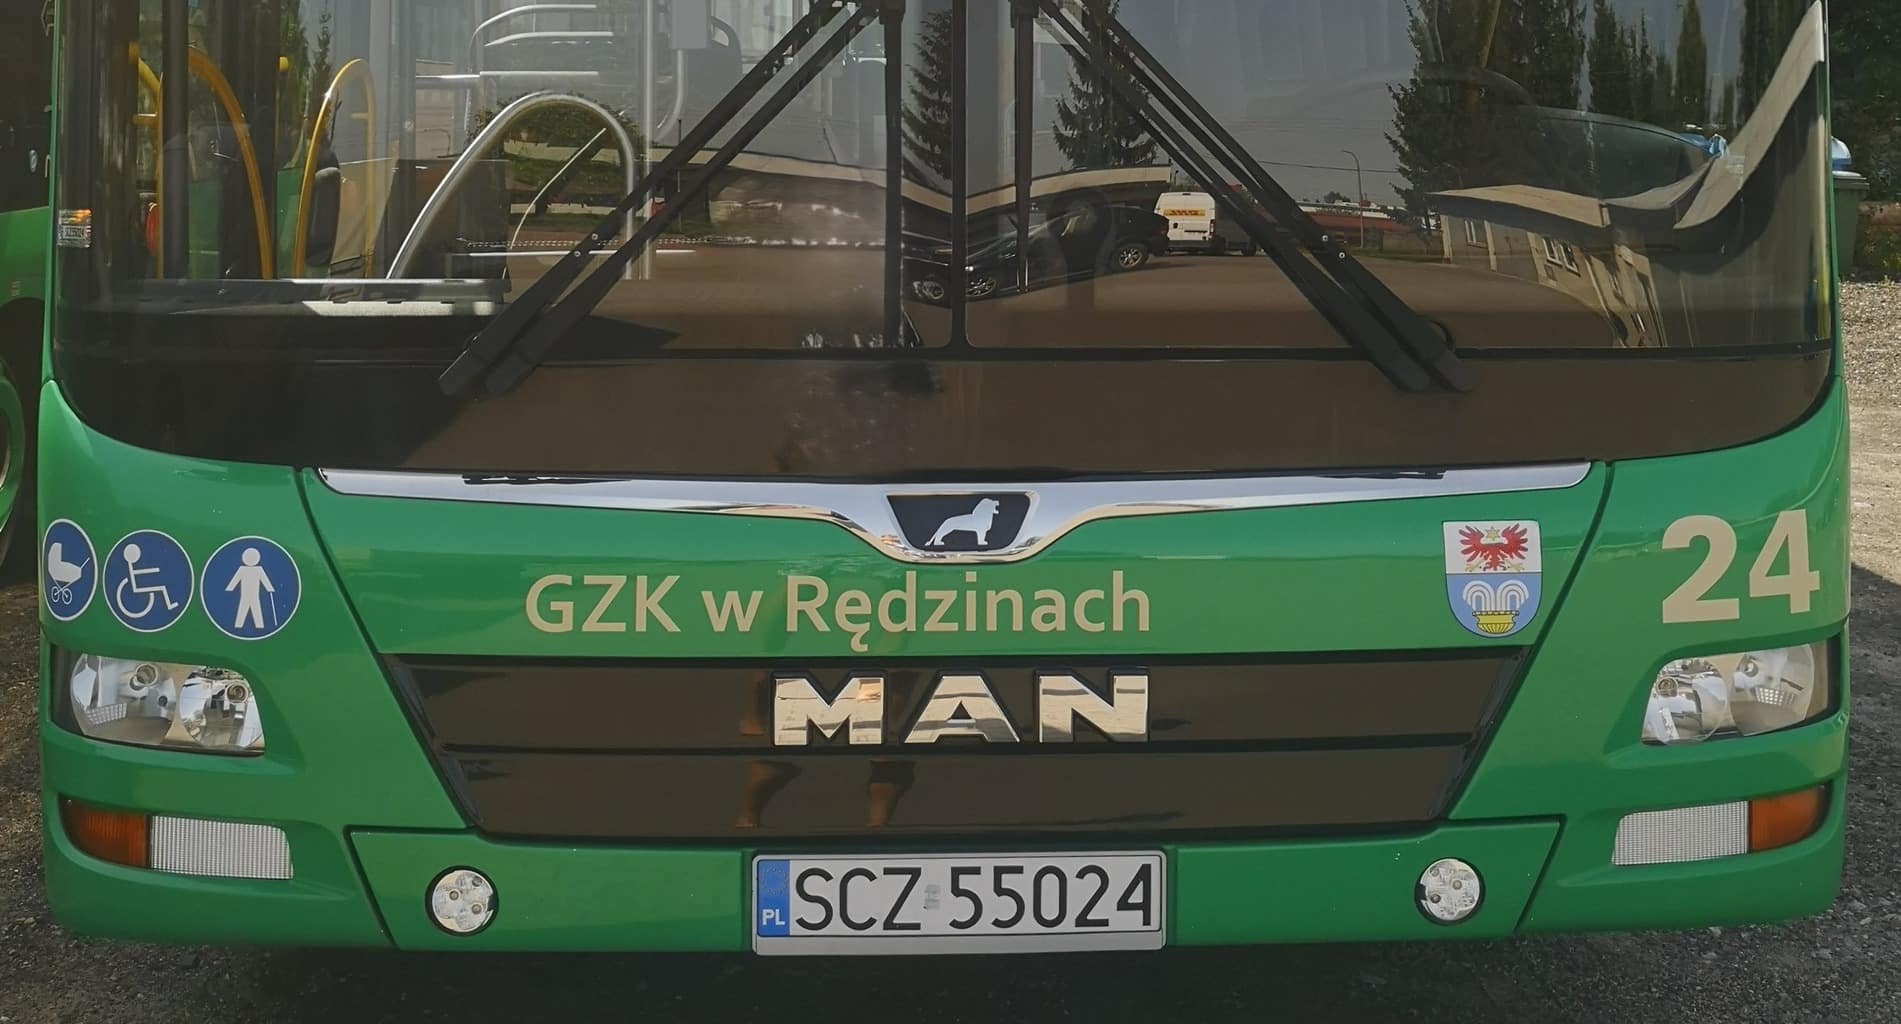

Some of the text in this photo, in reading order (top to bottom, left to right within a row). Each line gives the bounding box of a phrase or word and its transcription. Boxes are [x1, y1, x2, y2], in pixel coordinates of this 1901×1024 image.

[1661, 508, 1821, 624] 24
[526, 570, 1150, 653] GZK w Rędzinach
[772, 674, 1150, 746] MAN
[762, 909, 785, 926] PL
[795, 863, 1152, 931] SCZ 55024
